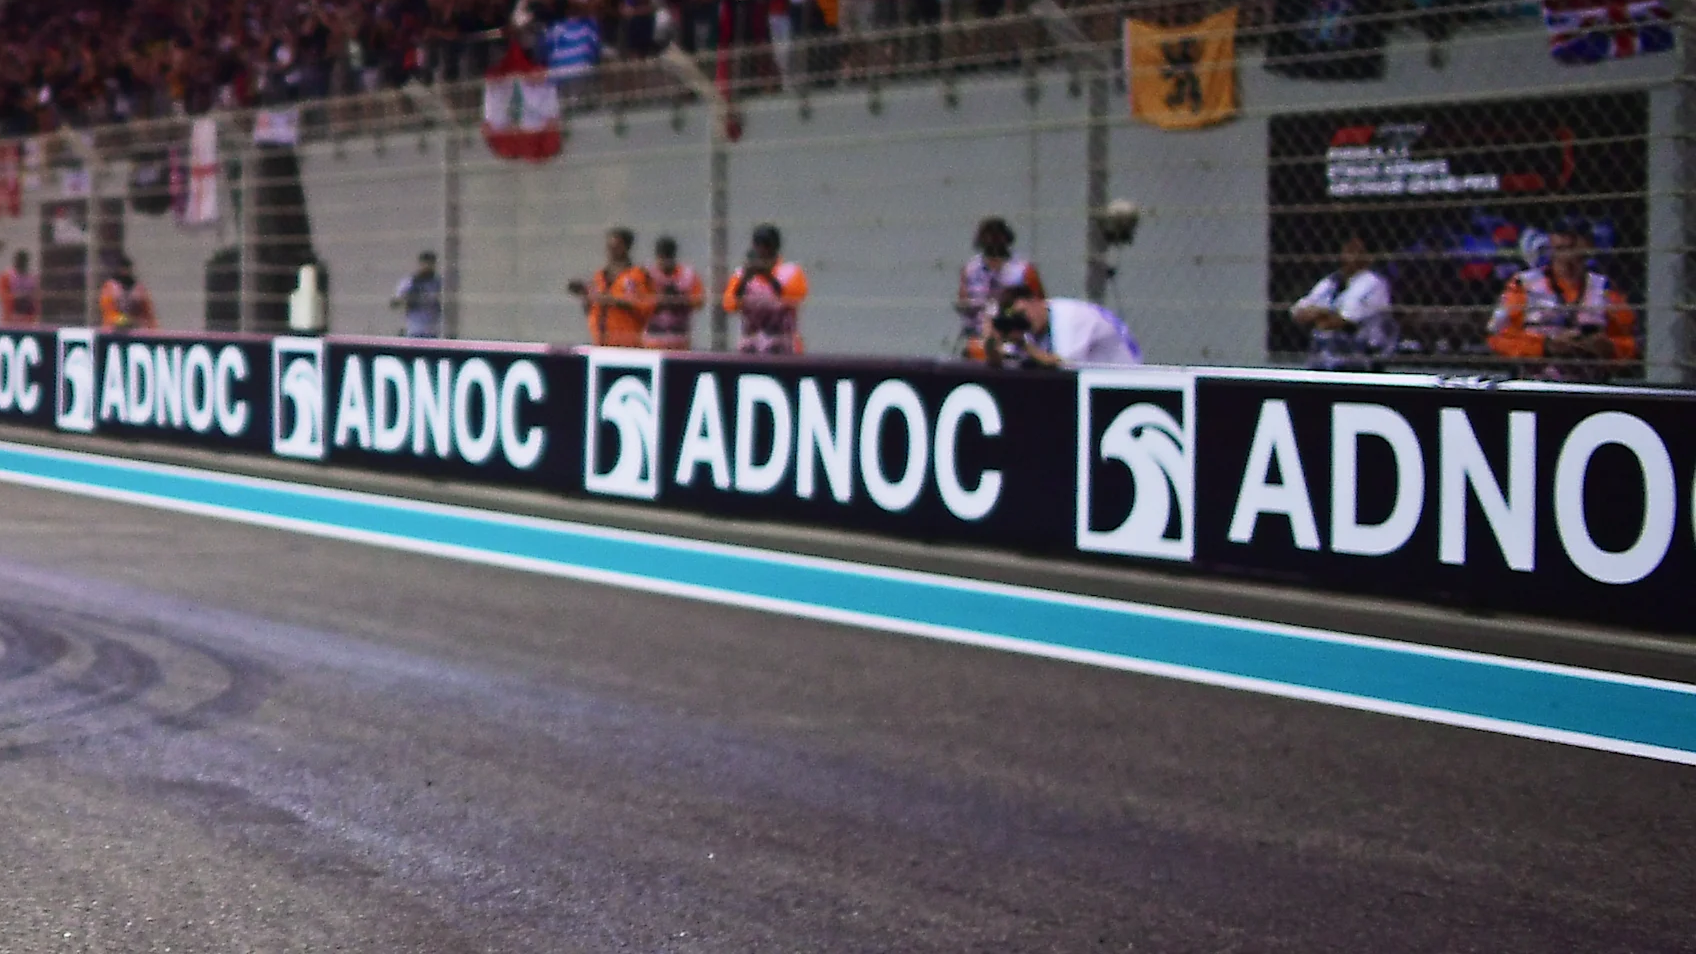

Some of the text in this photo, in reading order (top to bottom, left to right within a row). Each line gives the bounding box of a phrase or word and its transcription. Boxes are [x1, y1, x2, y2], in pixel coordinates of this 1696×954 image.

[101, 343, 250, 436] ADNOC
[335, 354, 545, 469] ADNOC
[675, 372, 1003, 521] ADNOC
[1227, 397, 1696, 585] ADNO
